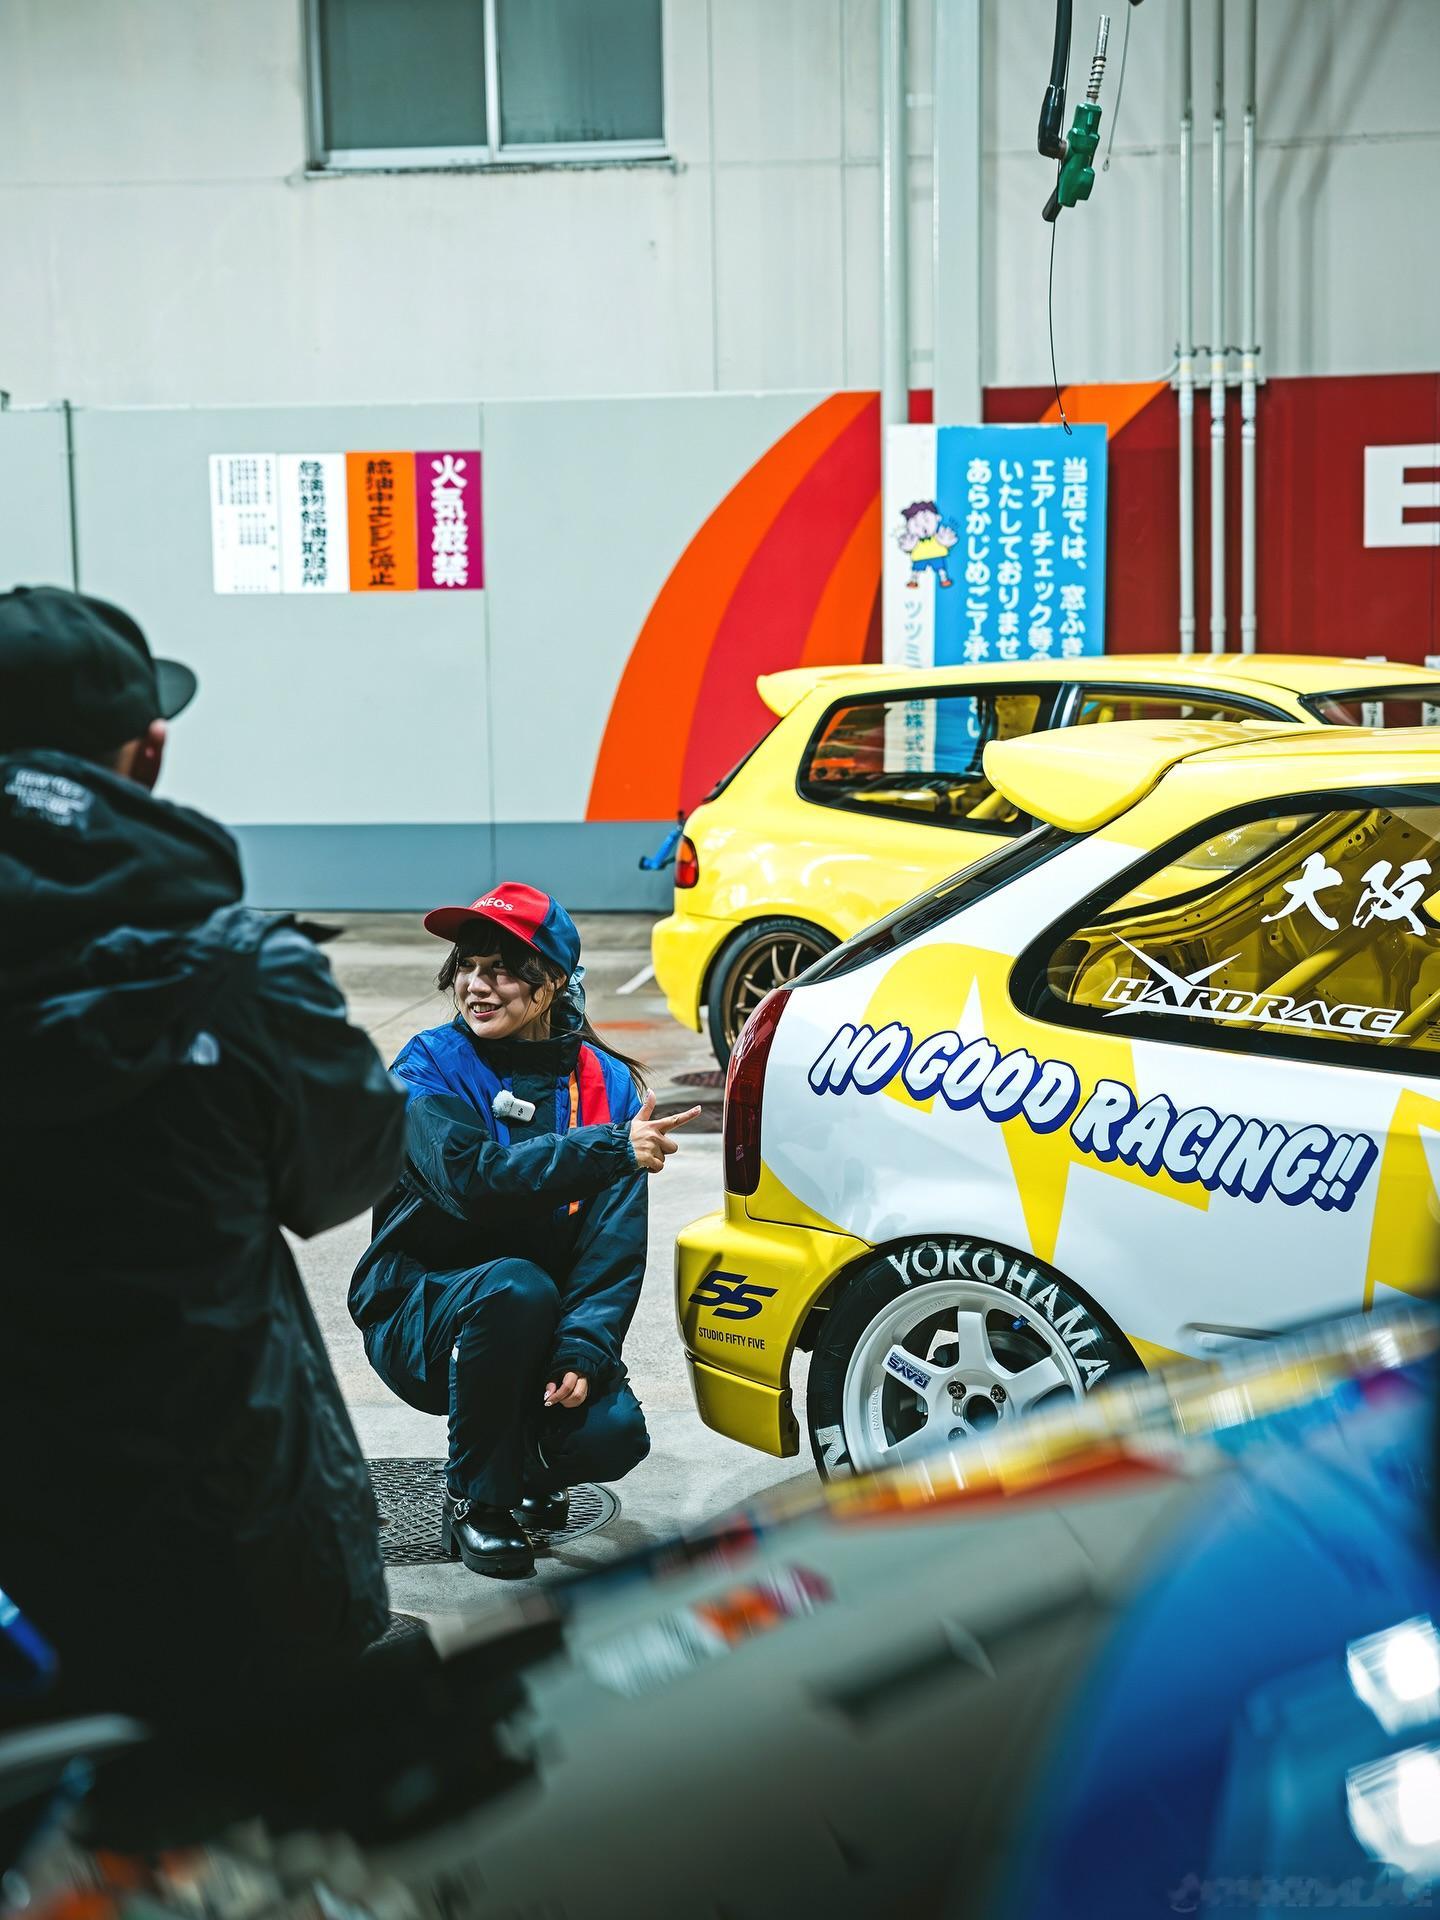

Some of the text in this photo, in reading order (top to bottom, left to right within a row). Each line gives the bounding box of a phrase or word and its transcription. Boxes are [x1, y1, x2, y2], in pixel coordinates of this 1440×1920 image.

[431, 454, 469, 587] 火気厳禁
[963, 457, 992, 666] あらかじめご了承
[996, 459, 1023, 660] いたしておりませ
[1101, 974, 1411, 1038] HARDRACE
[807, 1021, 1379, 1213] NO GOOD RACING!!
[698, 1326, 766, 1351] STUDIO FIFTY FIVE
[886, 1239, 1111, 1392] YOKOHAMA
[886, 1355, 930, 1391] RAYS
